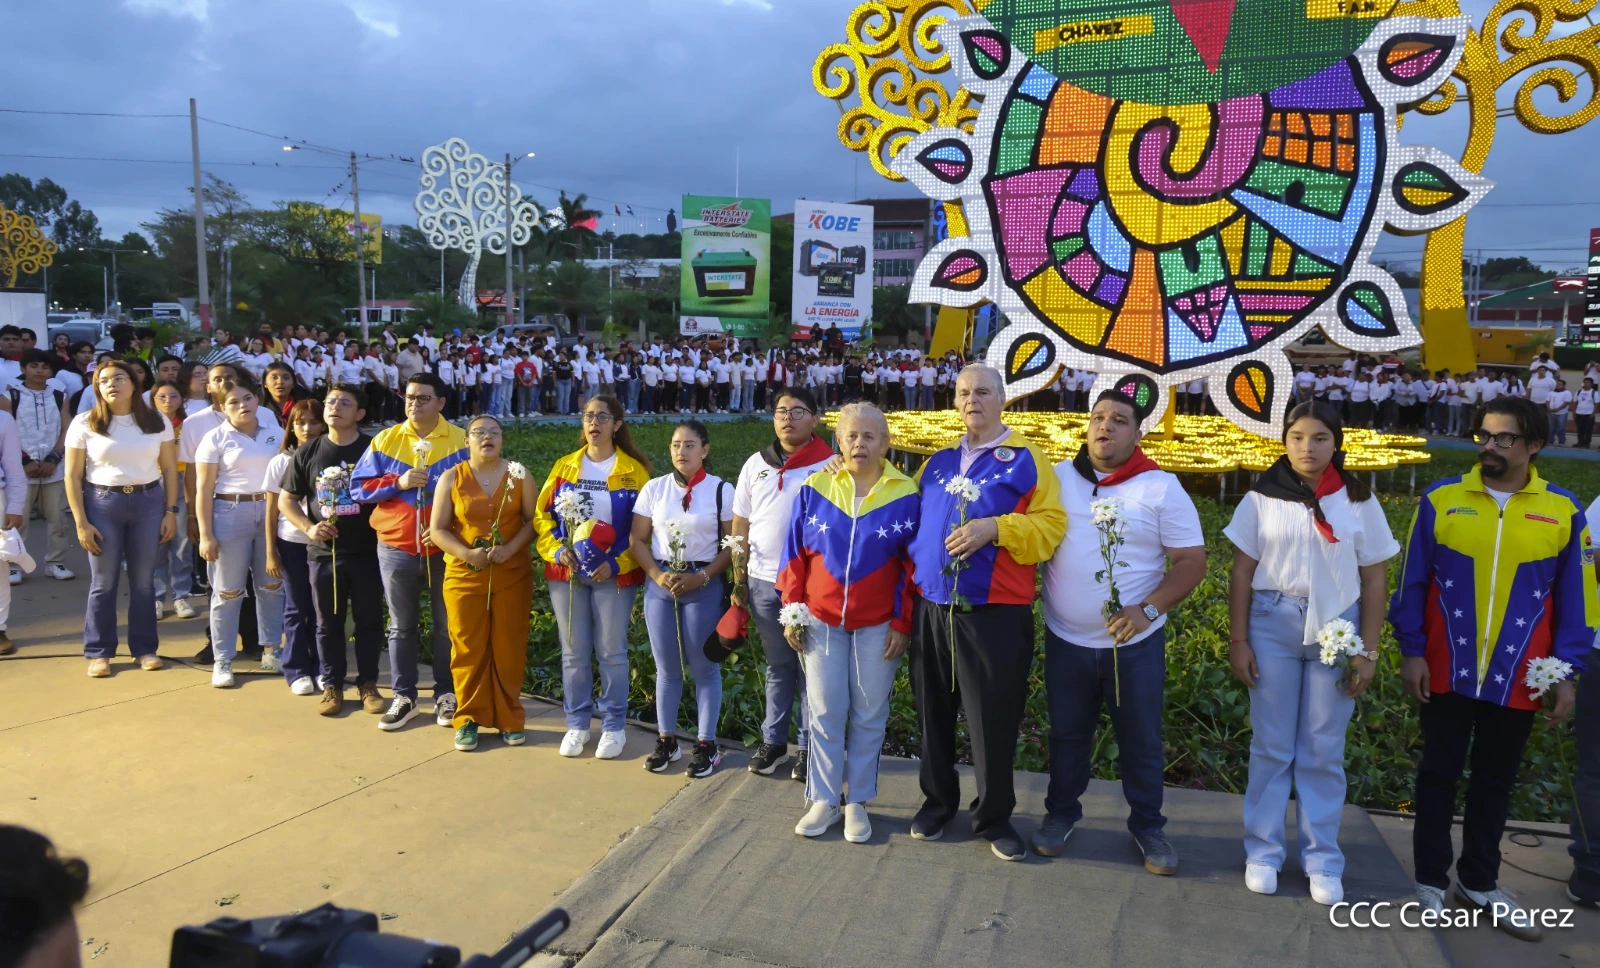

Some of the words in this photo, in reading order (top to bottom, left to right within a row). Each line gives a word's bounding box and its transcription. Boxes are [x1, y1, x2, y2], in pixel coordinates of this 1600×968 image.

[1337, 1, 1380, 15] F.A.N.
[1058, 22, 1124, 42] CHAVEZ
[702, 209, 750, 218] INTERSTATE
[808, 214, 861, 232] KOBE
[824, 276, 843, 284] KOBE
[804, 307, 816, 315] LA
[818, 307, 860, 317] ENERGÍA
